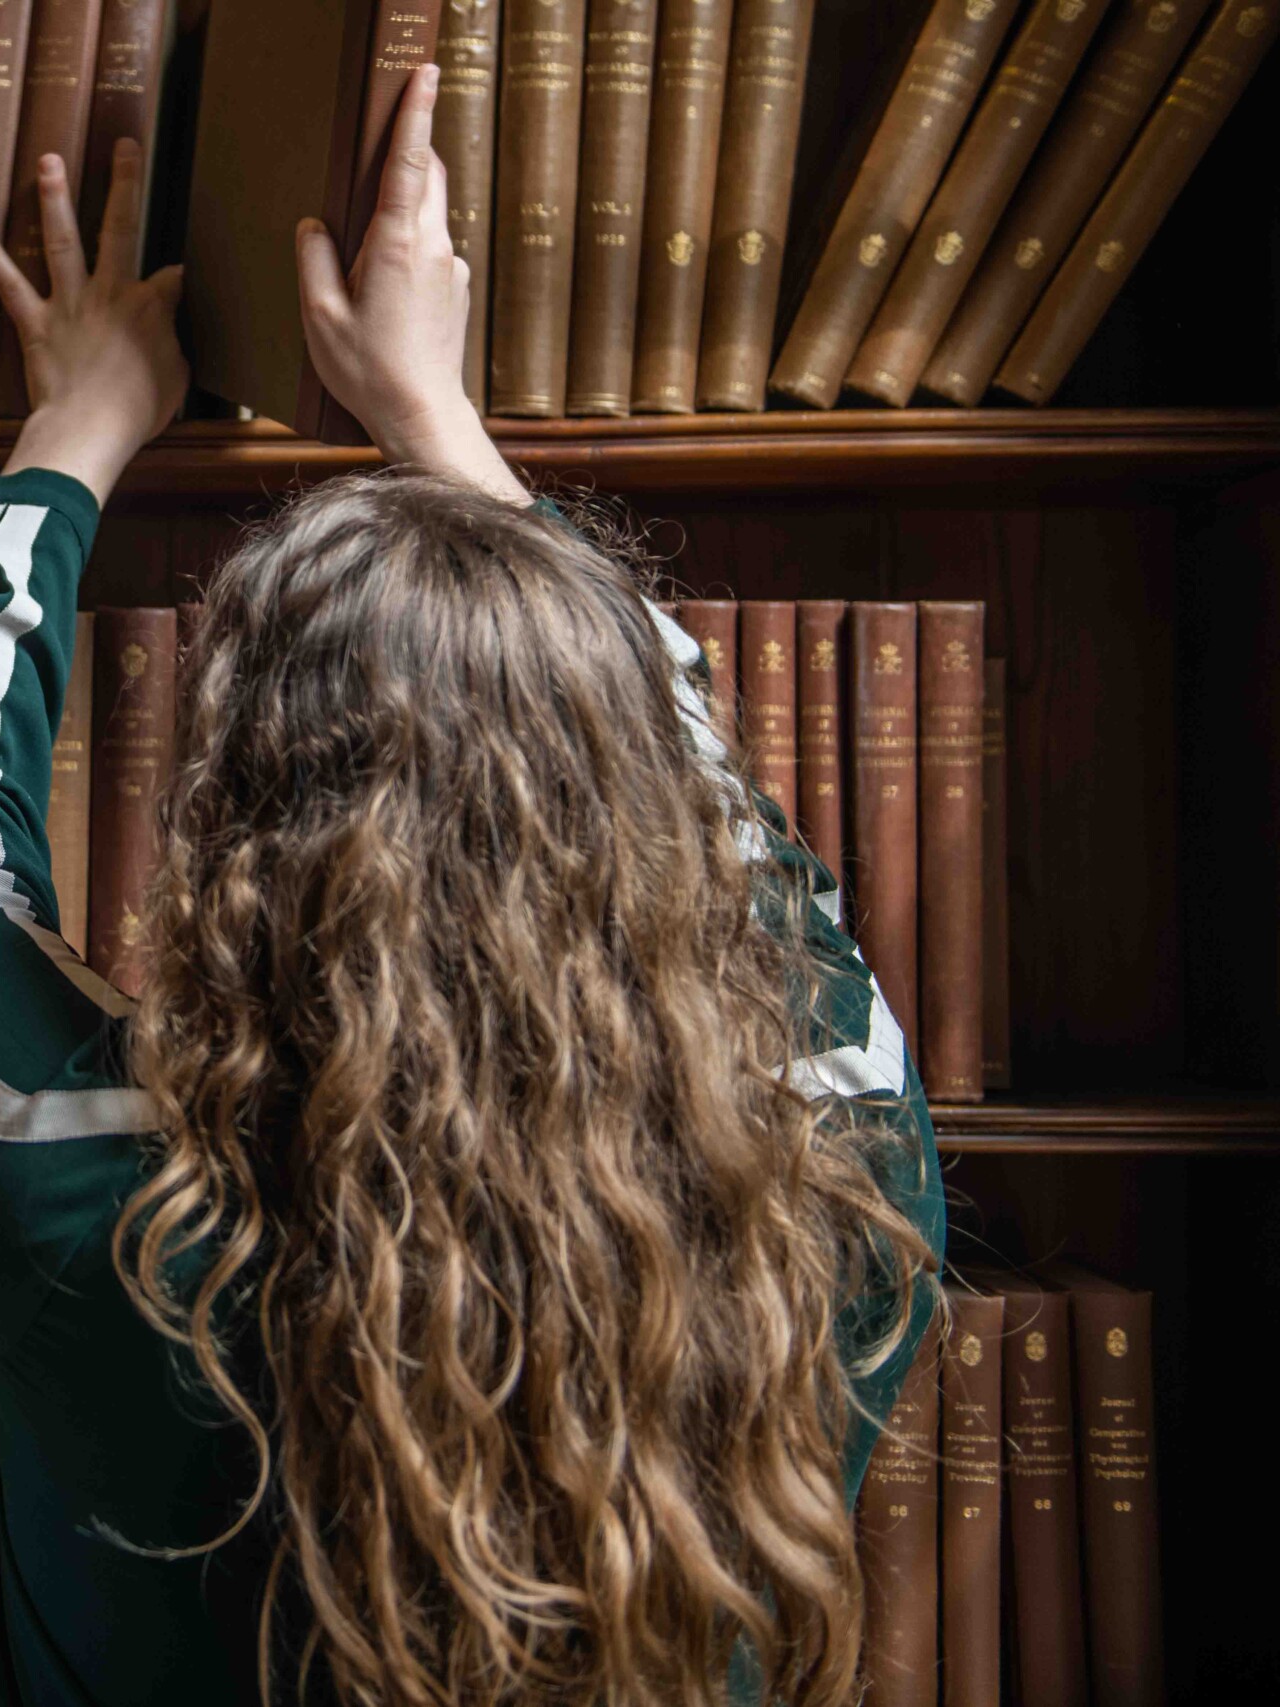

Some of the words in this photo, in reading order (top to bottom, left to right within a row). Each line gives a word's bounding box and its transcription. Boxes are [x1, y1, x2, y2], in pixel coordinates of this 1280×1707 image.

[390, 11, 428, 23] Journal
[402, 28, 414, 37] of
[384, 42, 425, 54] Applied
[1020, 1397, 1056, 1406] Journal
[1101, 1397, 1135, 1408] Journal
[1114, 1414, 1124, 1423] of
[1089, 1427, 1146, 1439] Comparative
[1110, 1442, 1127, 1450] and
[1094, 1467, 1145, 1480] Psychology
[1034, 1499, 1052, 1511] 68
[1113, 1500, 1131, 1512] 69
[963, 1506, 981, 1519] 67
